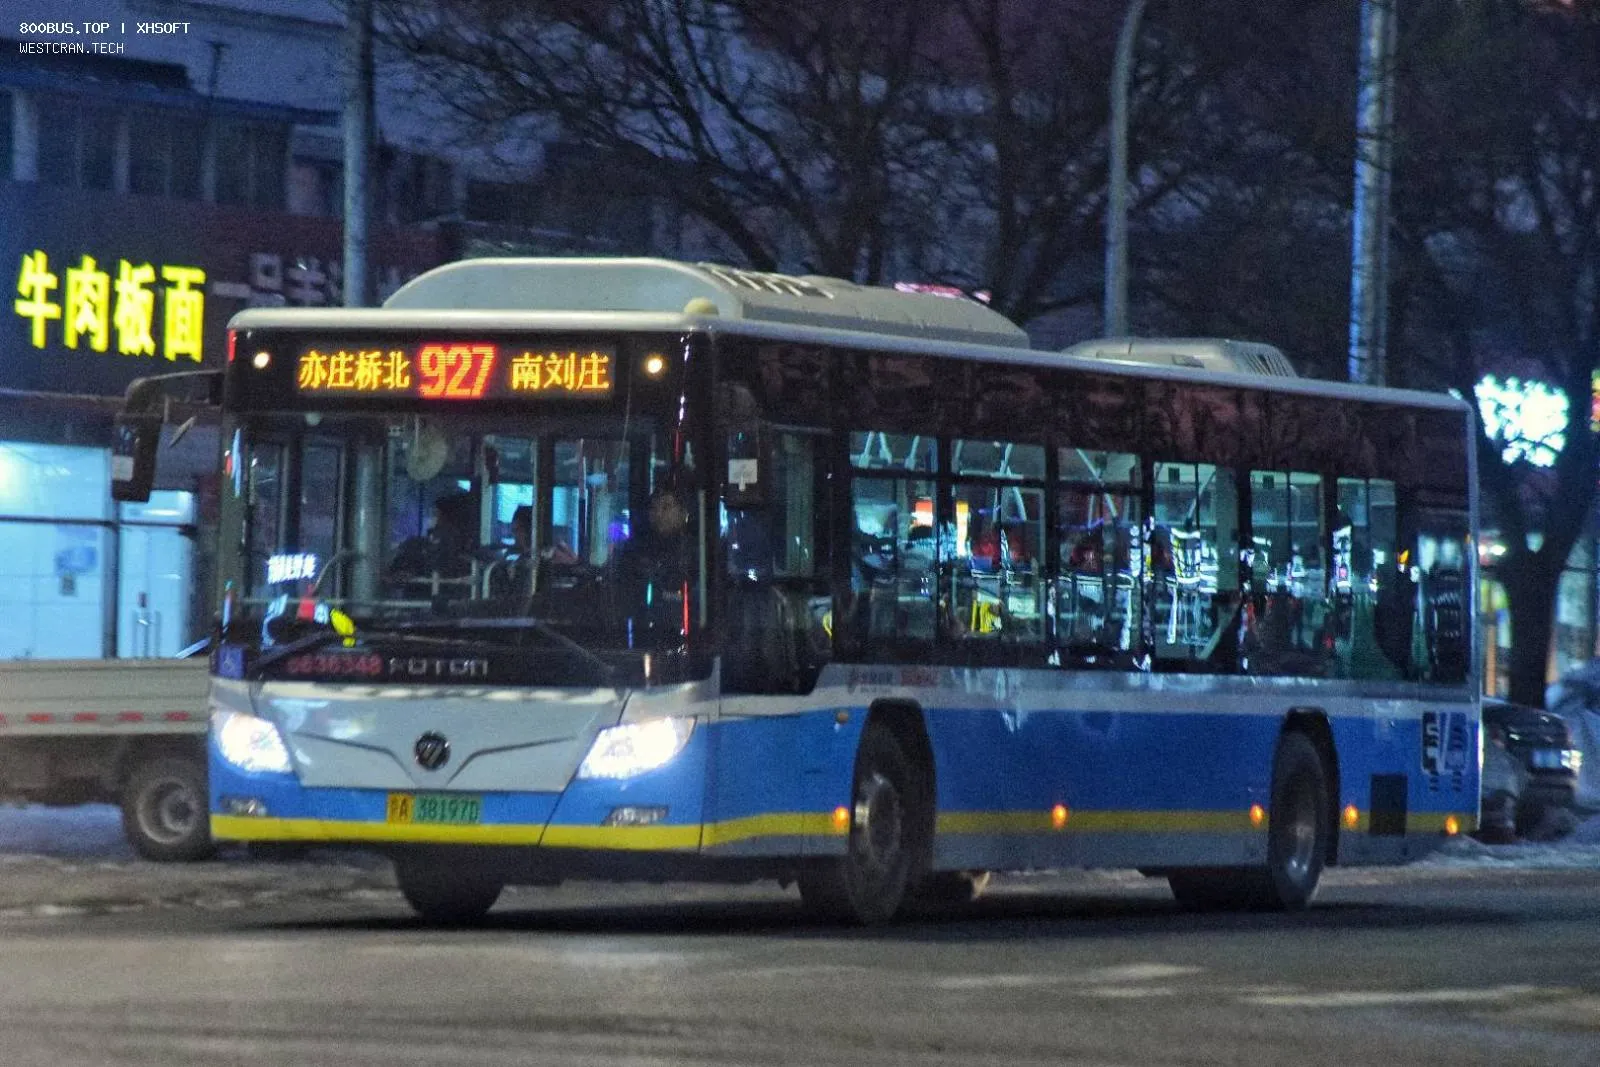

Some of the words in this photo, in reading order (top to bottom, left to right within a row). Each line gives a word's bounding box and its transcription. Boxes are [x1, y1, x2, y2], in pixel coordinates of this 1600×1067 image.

[14, 249, 206, 363] 牛肉板面
[299, 350, 411, 391] 亦庄桥北
[419, 344, 496, 399] 927
[510, 351, 610, 391] 南刘庄
